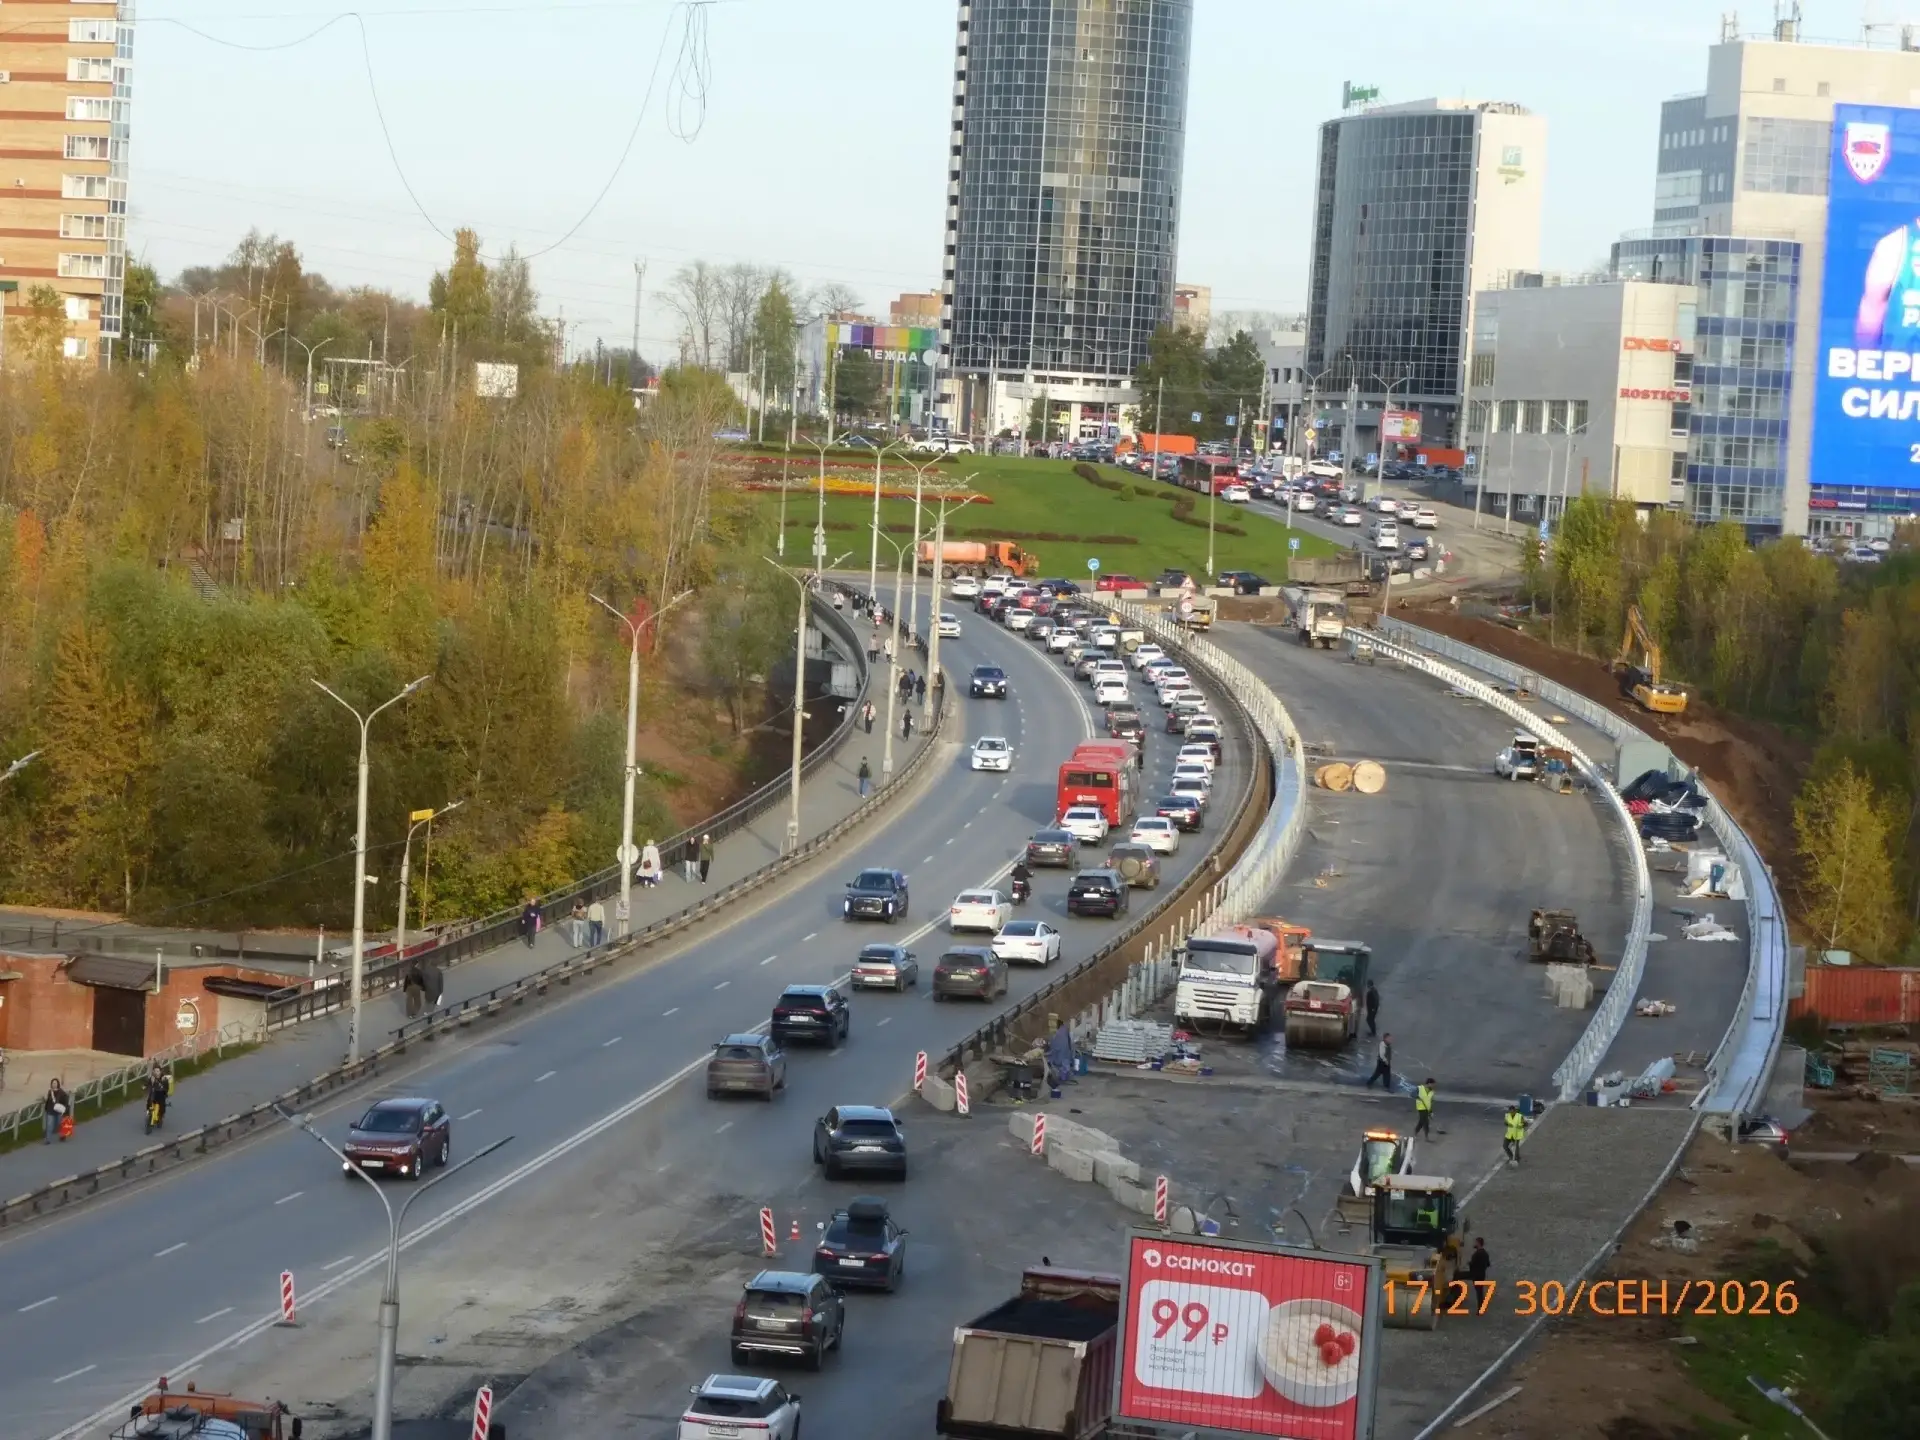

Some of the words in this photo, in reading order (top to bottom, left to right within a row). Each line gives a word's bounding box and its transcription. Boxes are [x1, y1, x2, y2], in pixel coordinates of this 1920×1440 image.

[1623, 337, 1669, 352] DNS
[1620, 388, 1690, 401] ROSTIC'S
[1337, 1275, 1350, 1287] 6+
[1152, 1299, 1209, 1342] 99
